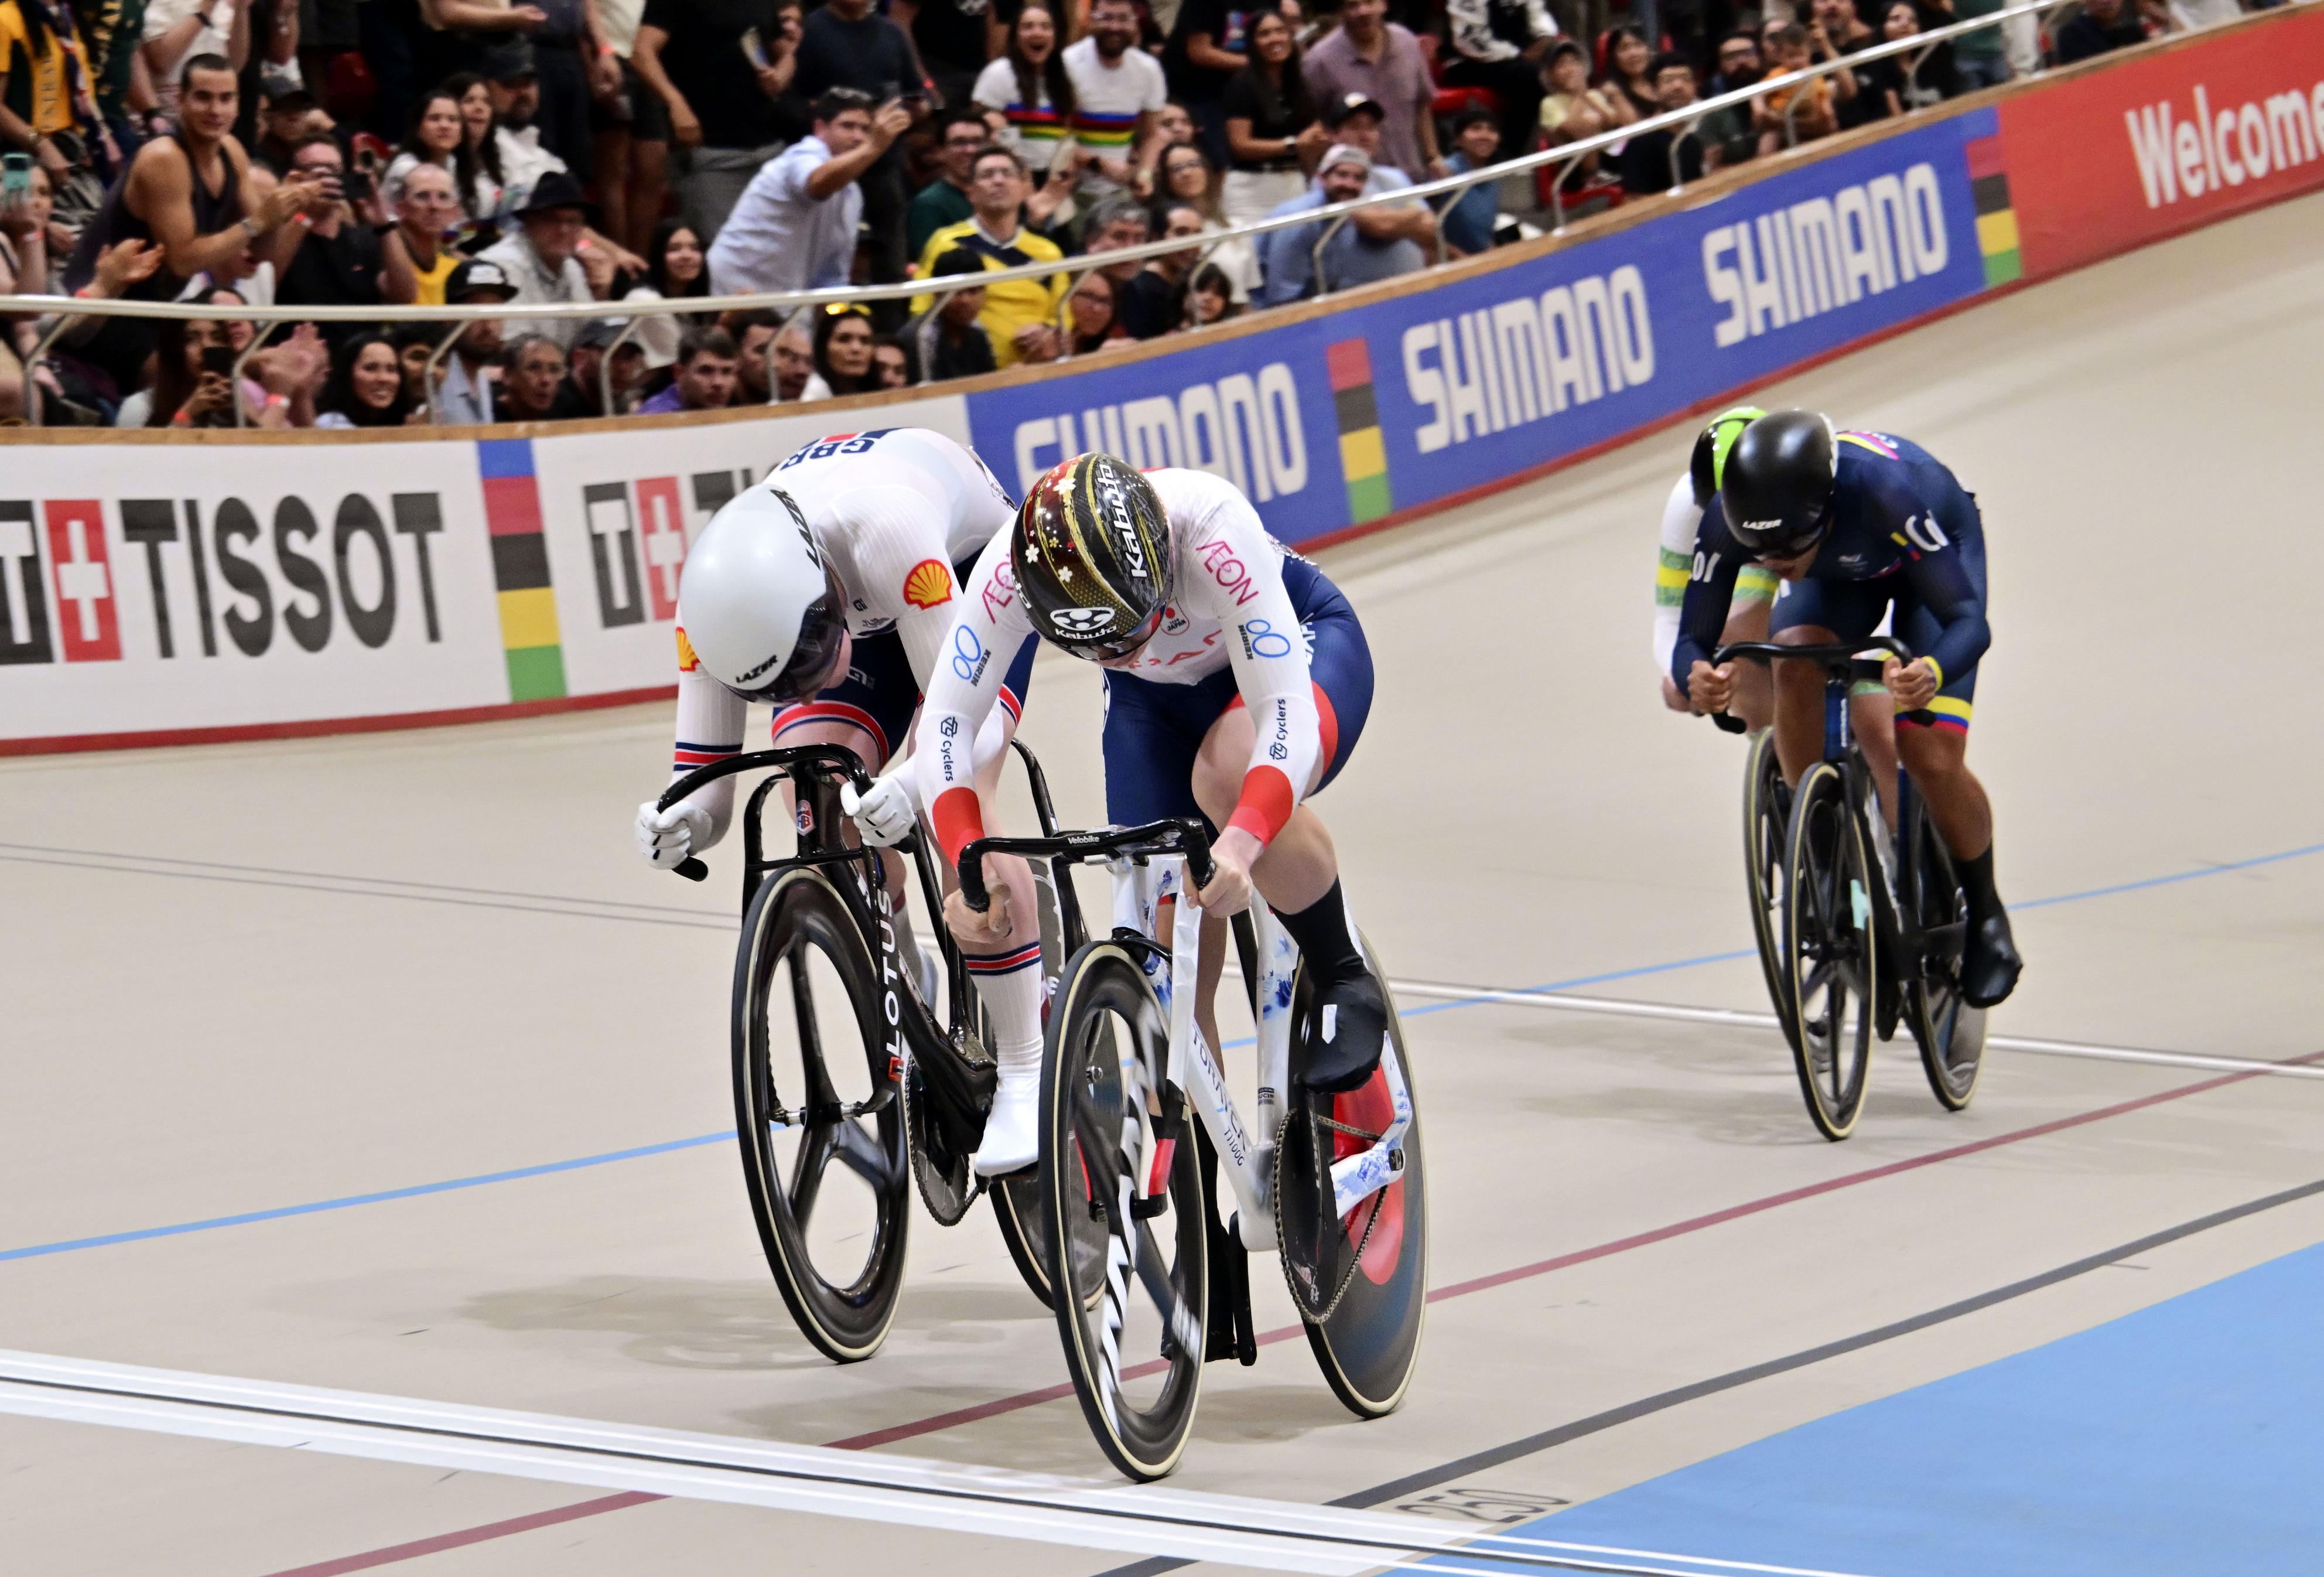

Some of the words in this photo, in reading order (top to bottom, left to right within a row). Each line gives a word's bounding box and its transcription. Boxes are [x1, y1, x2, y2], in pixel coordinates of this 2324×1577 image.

[2124, 81, 2324, 209] Welcome
[1703, 163, 1949, 347] SHIMANO
[1402, 264, 1655, 454] SHIMANO
[780, 439, 875, 471] GBR
[770, 489, 821, 572] LAZER
[1098, 463, 1147, 578] Kabuto
[1742, 519, 1782, 530] LAZER
[119, 493, 444, 658] TISSOT
[1055, 626, 1117, 641] Kabuto
[1238, 624, 1254, 661] KEIRIN
[736, 654, 778, 684] LAZER
[970, 648, 992, 688] KEIRIN
[1276, 698, 1287, 740] Cyclers
[941, 740, 953, 782] Cyclers
[1068, 835, 1100, 844] Velobike
[877, 888, 900, 1056] LOTUS
[1224, 1126, 1245, 1167] T1100G
